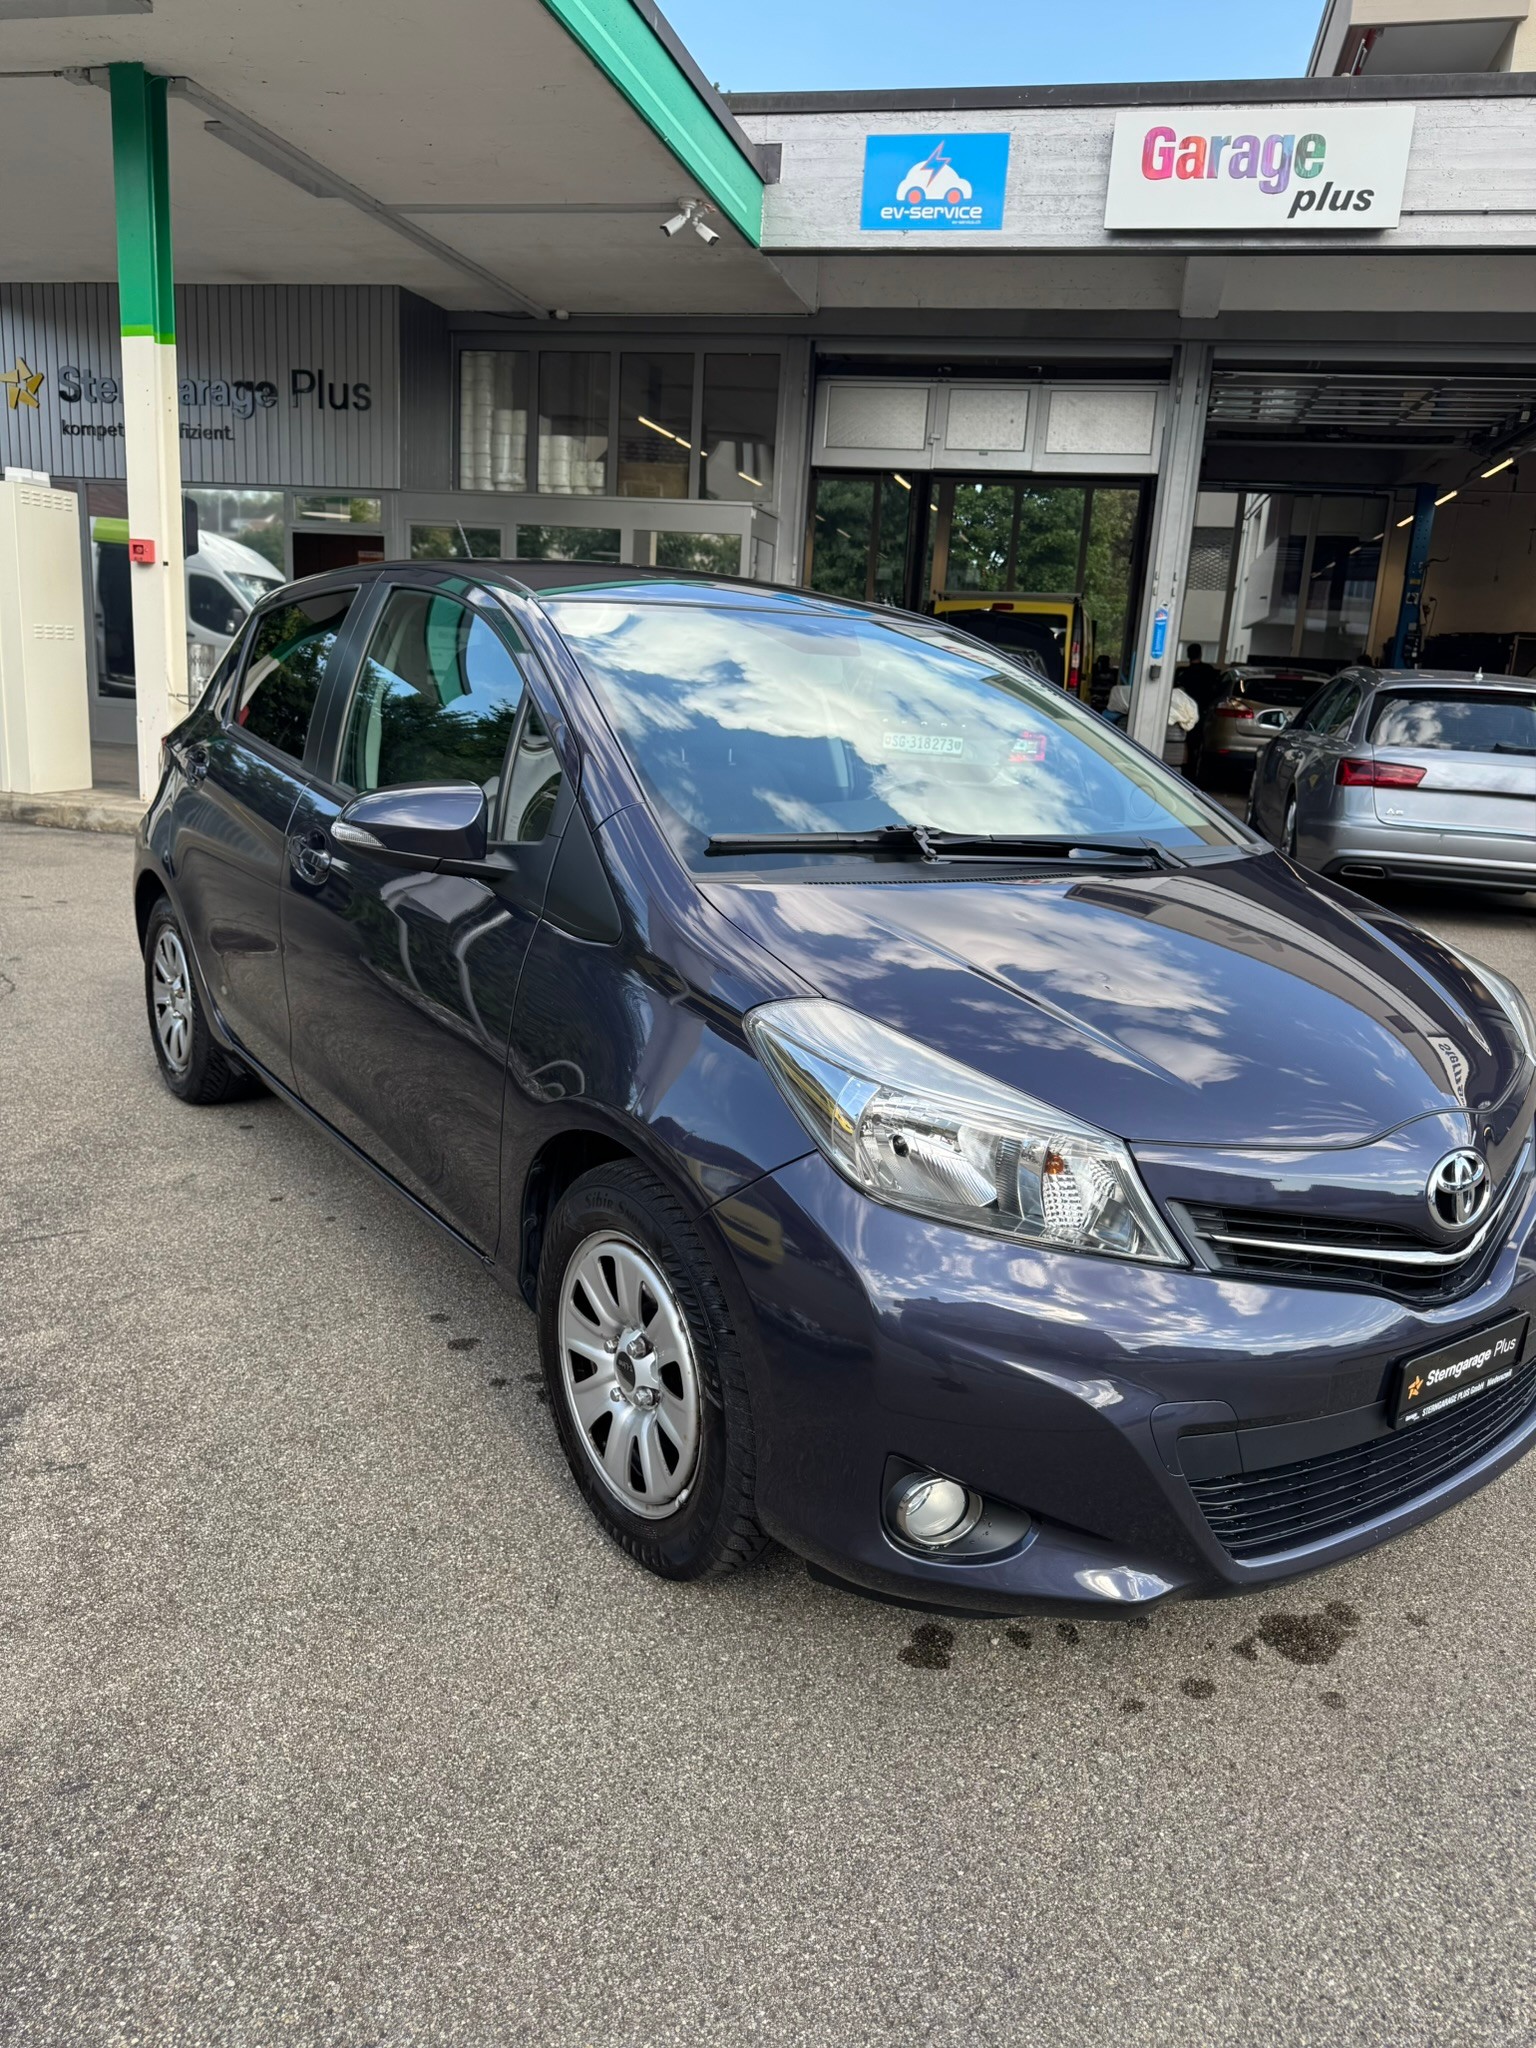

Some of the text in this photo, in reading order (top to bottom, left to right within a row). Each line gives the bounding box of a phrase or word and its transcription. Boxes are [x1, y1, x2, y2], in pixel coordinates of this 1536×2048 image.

[1141, 126, 1327, 194] Garage
[880, 206, 983, 219] ev-service
[1287, 181, 1375, 219] plus
[58, 365, 372, 420] Stearage Plus
[61, 419, 125, 441] kompet
[1426, 1338, 1517, 1387] Sterngarage Plus
